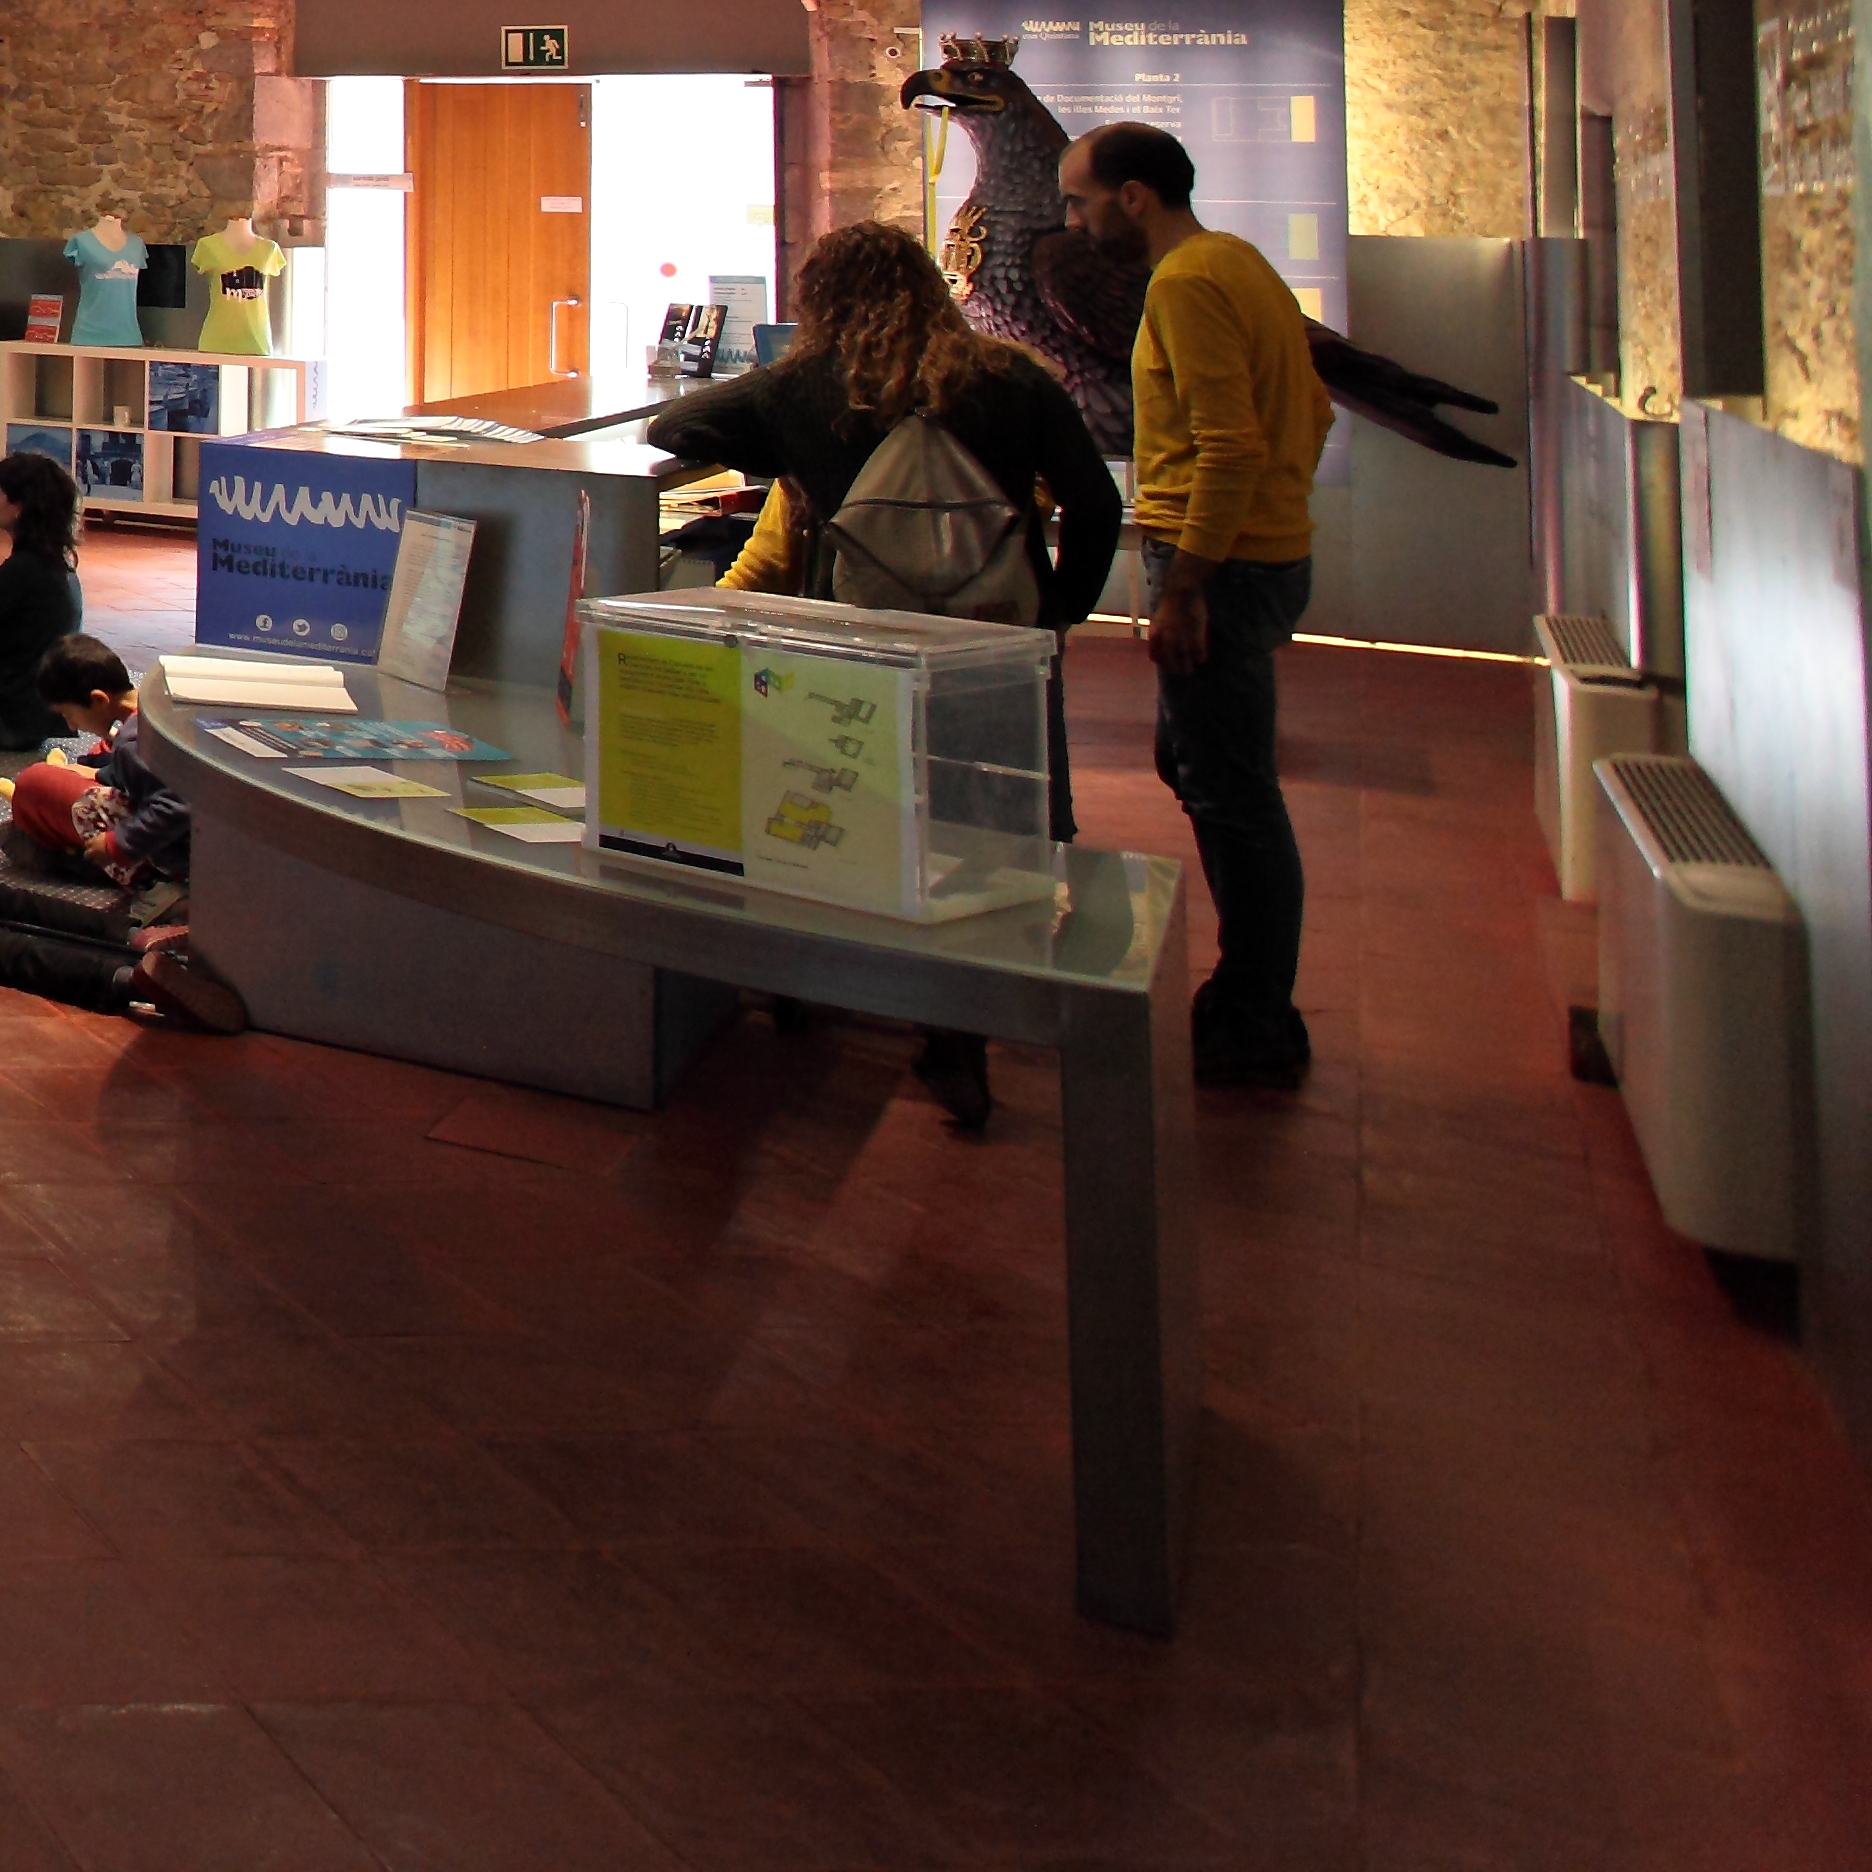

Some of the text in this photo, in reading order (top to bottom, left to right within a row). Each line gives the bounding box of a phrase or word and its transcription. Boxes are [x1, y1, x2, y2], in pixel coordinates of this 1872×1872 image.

[1088, 20, 1179, 31] Museu de la
[1088, 29, 1247, 46] Mediterrània
[1134, 73, 1180, 82] Planta 2
[1043, 94, 1055, 103] de
[1056, 94, 1123, 103] Documentació
[1125, 94, 1141, 103] del
[212, 537, 276, 558] Museu
[212, 552, 393, 590] Mediterrània
